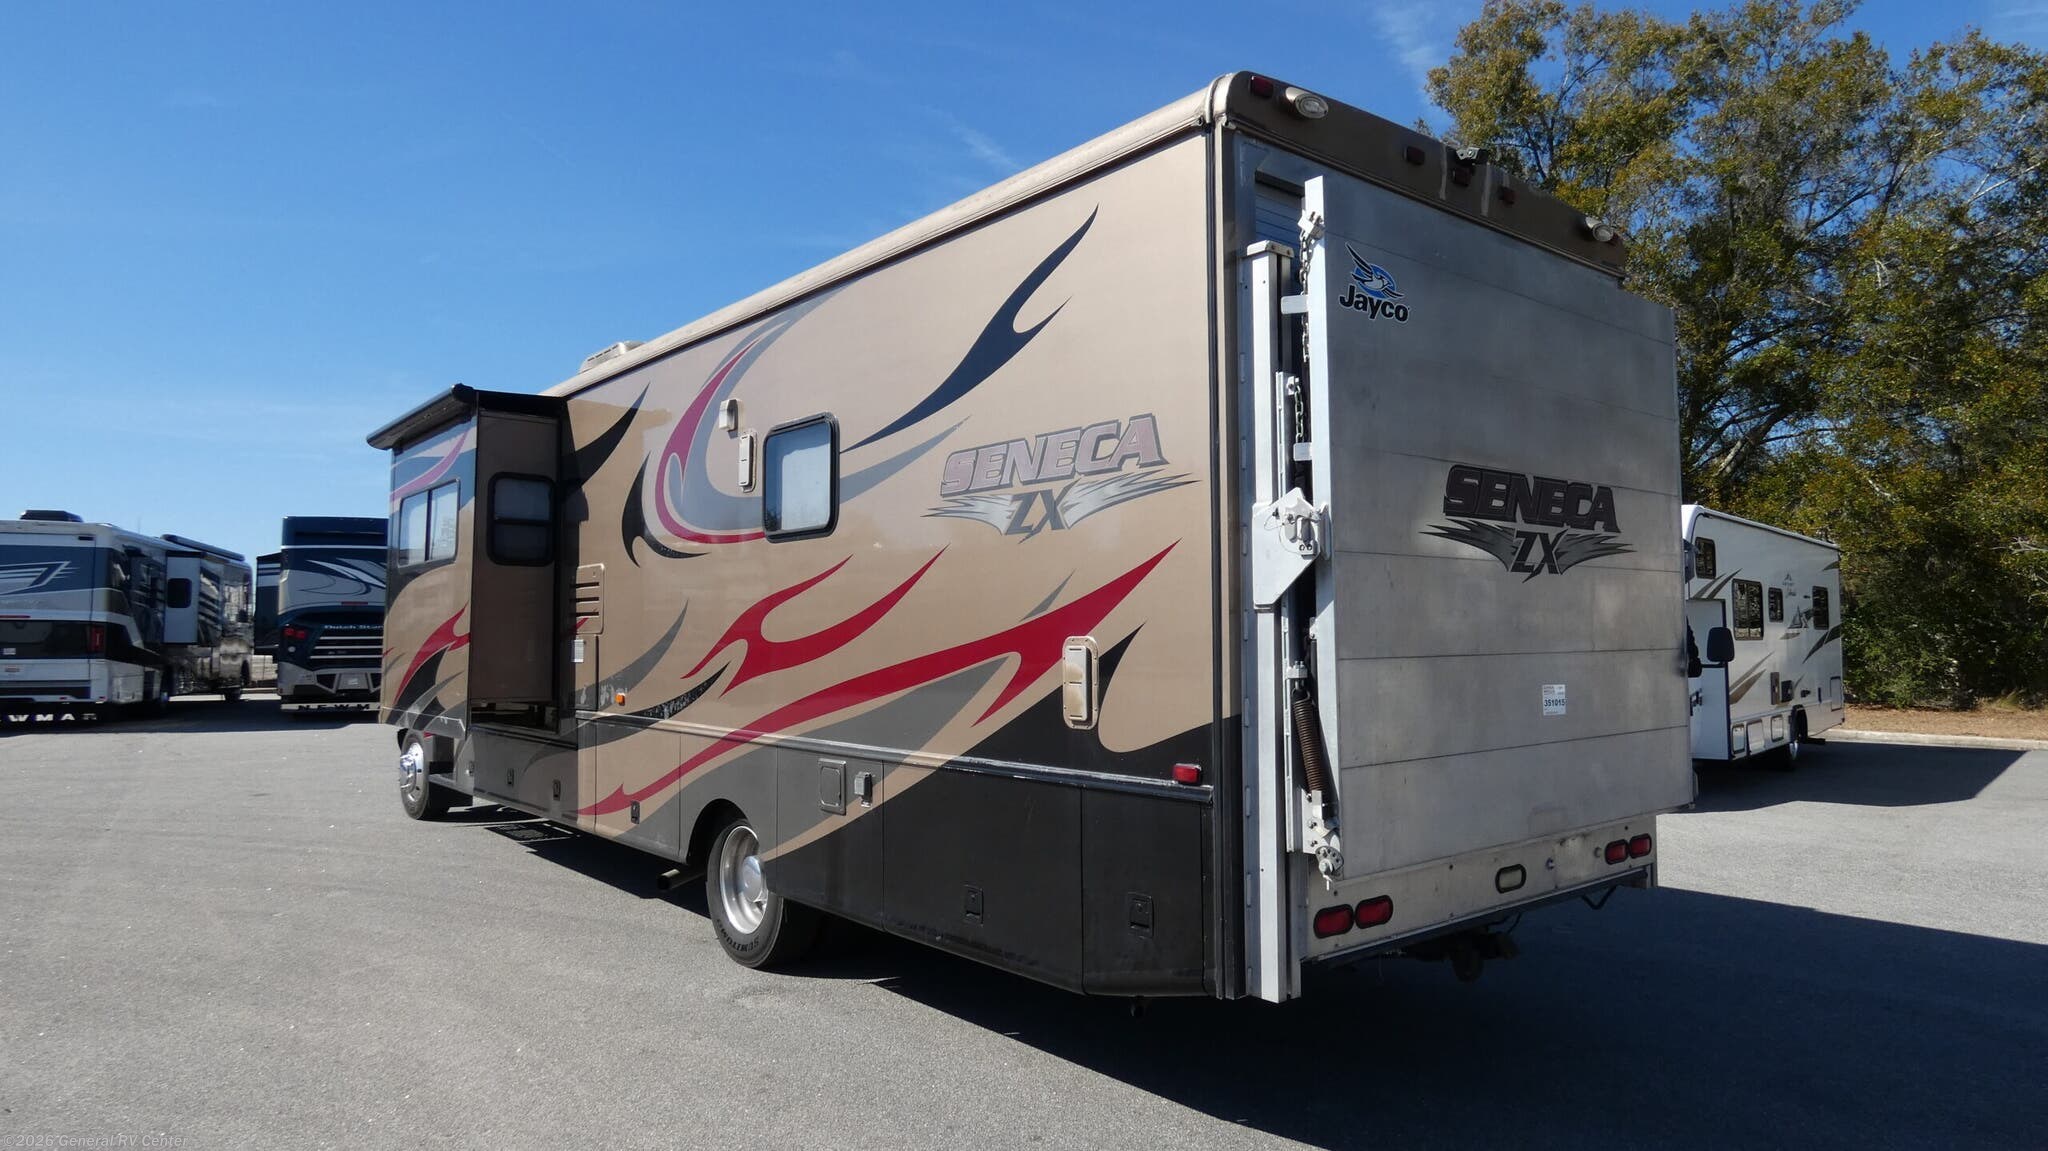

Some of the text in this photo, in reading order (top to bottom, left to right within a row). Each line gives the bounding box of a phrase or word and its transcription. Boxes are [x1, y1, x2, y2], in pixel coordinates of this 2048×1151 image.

[1339, 284, 1410, 322] Jayco
[942, 413, 1170, 497] SENECA
[1005, 478, 1082, 544] ZX
[1443, 464, 1622, 533] SENECA
[1510, 527, 1570, 584] ZX
